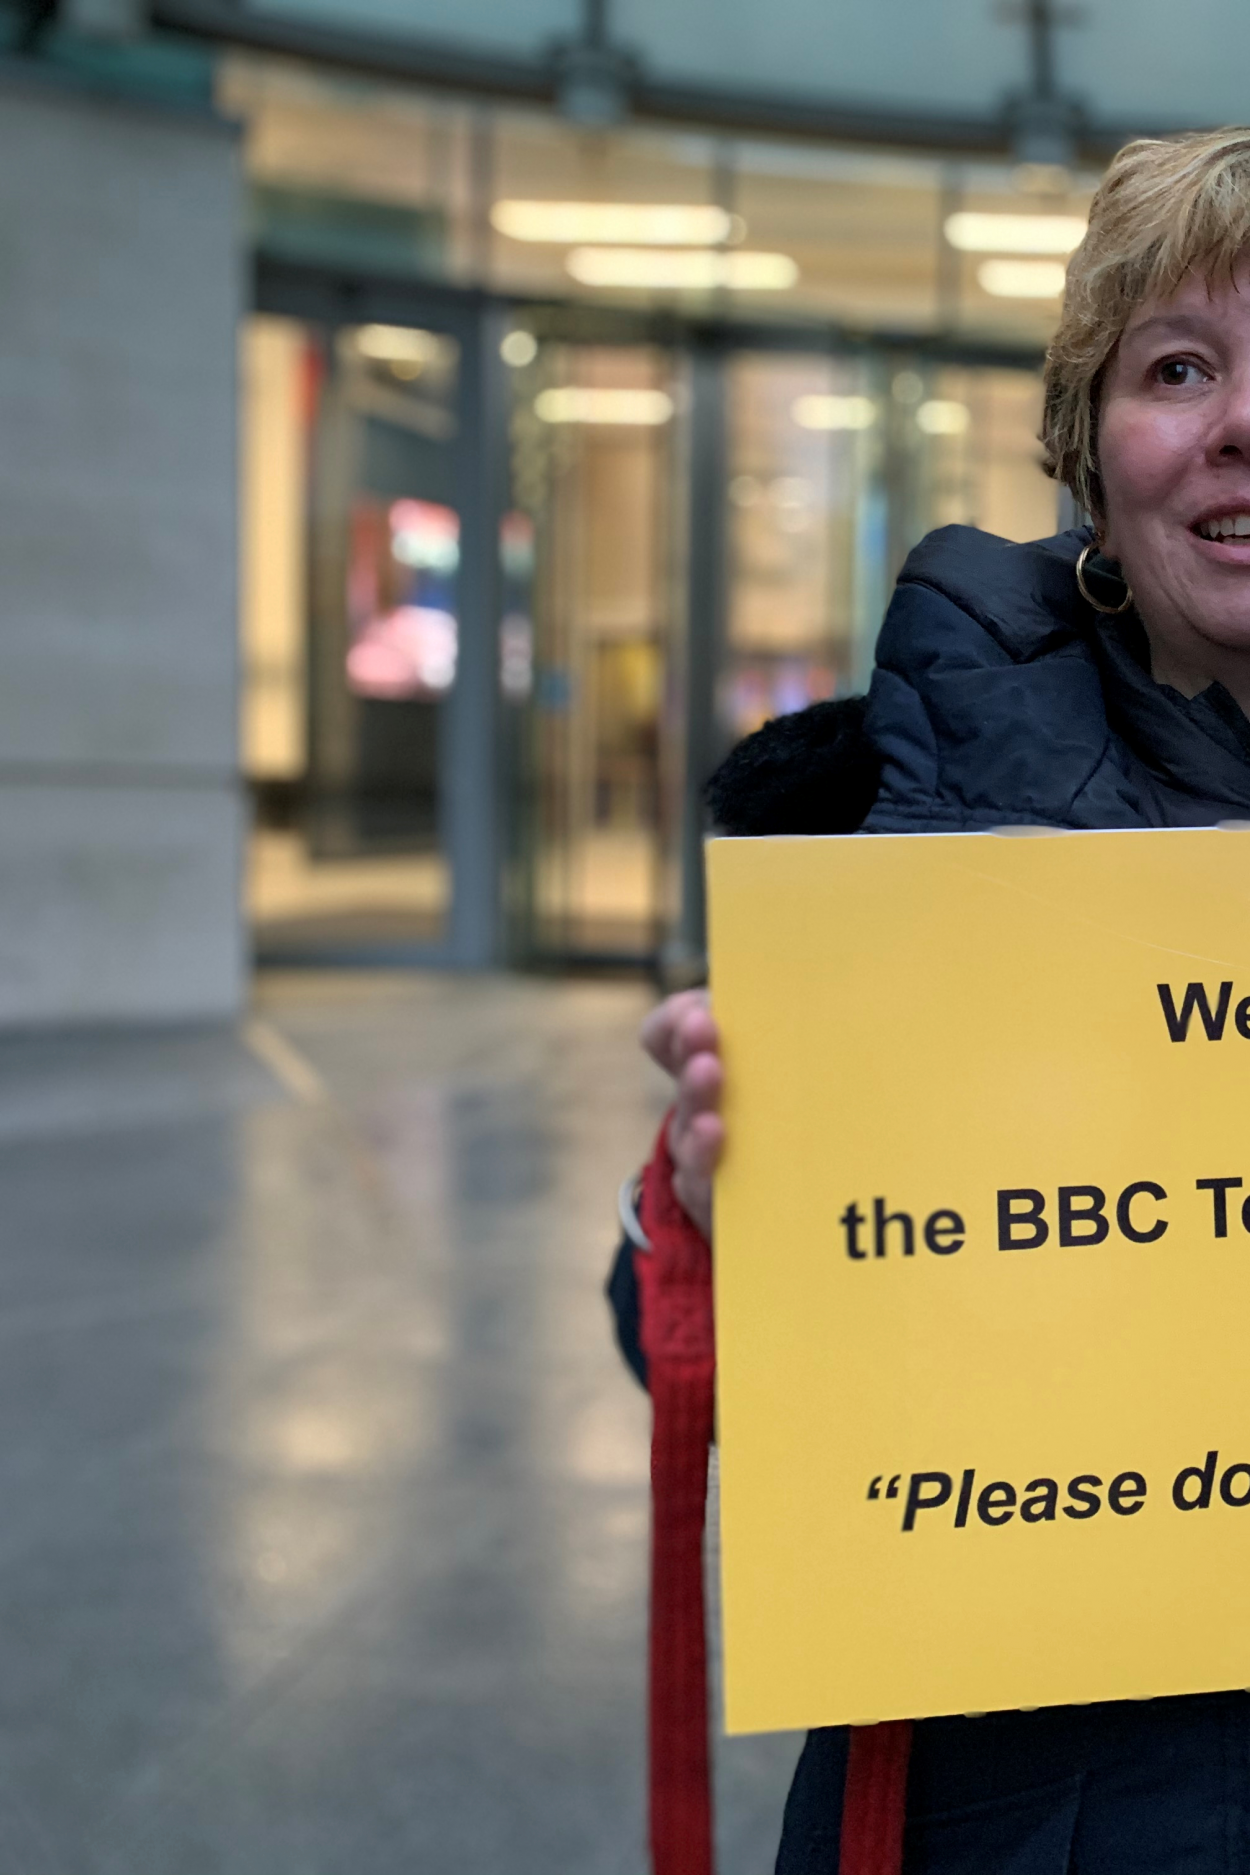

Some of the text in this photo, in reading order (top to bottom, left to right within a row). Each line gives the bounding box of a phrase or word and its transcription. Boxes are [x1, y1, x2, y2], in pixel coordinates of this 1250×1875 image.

[840, 1198, 965, 1263] the
[997, 1180, 1169, 1251] BBC
[867, 1470, 1147, 1532] “Please
